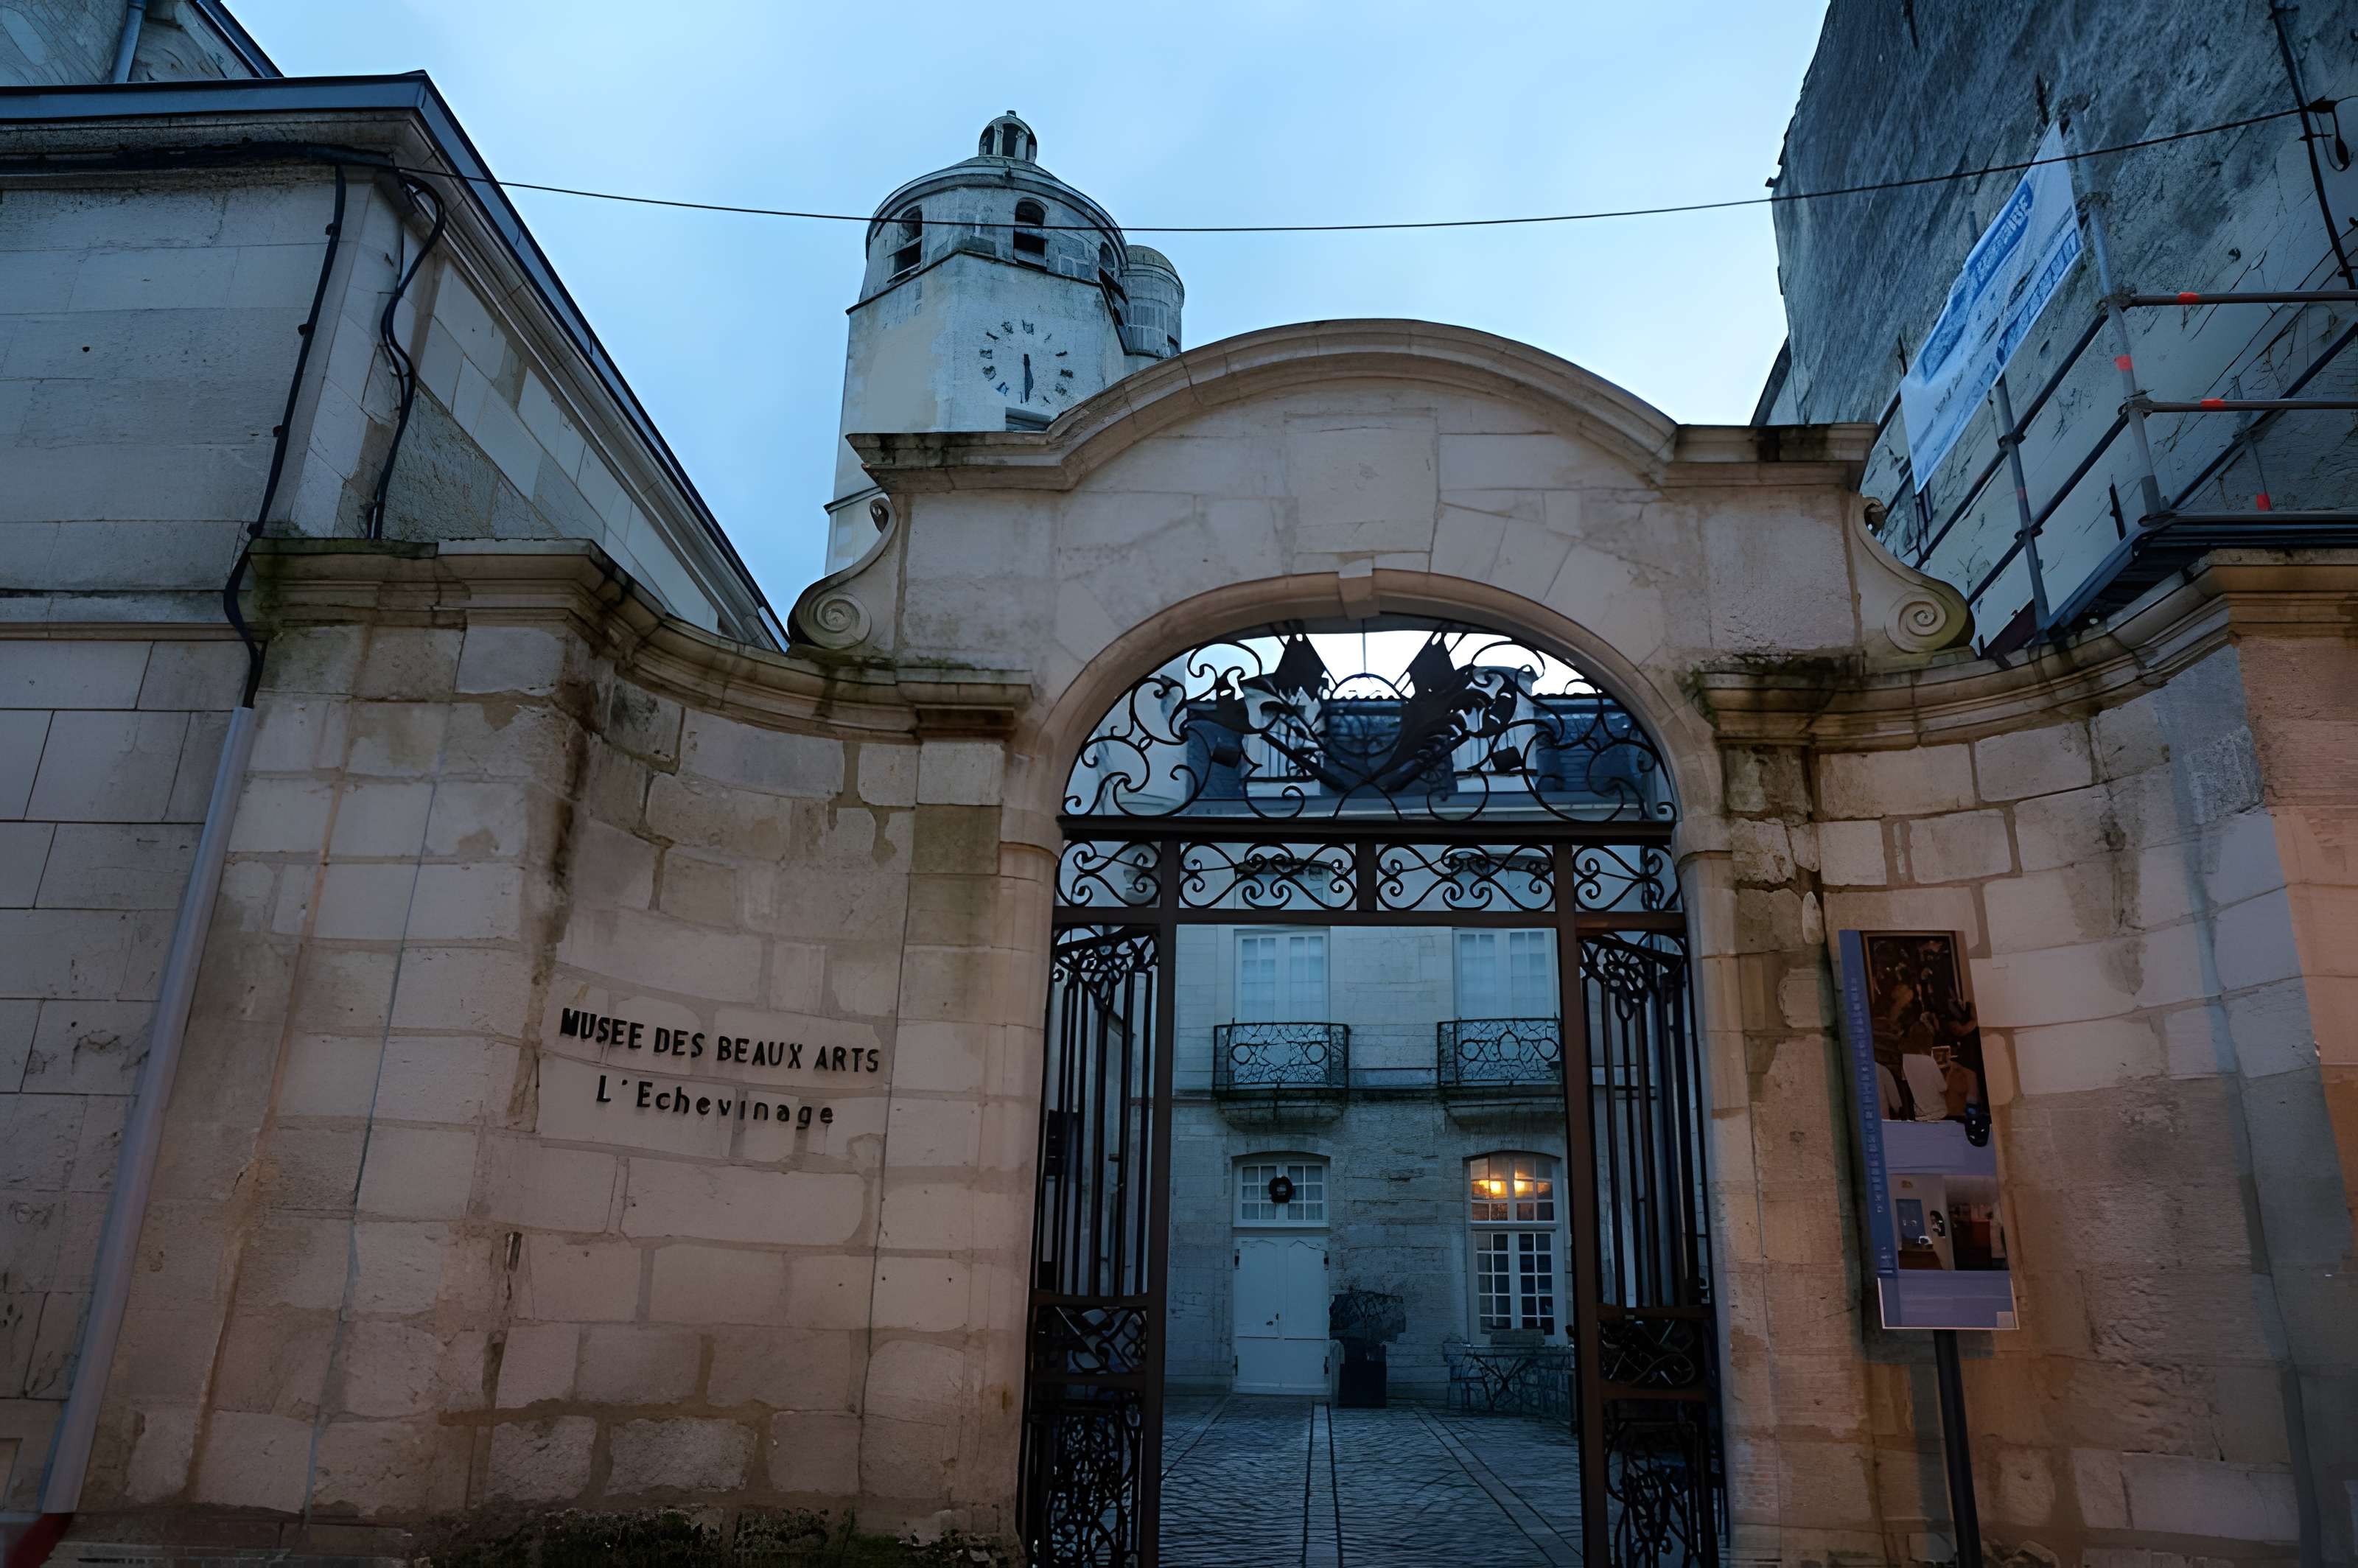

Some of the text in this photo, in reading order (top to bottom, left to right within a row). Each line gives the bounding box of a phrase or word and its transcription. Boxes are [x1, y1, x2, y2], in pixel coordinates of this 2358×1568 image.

[560, 1008, 878, 1072] MUSEE DES BEAUX ARTS
[597, 1075, 833, 1130] L'Echevinage
